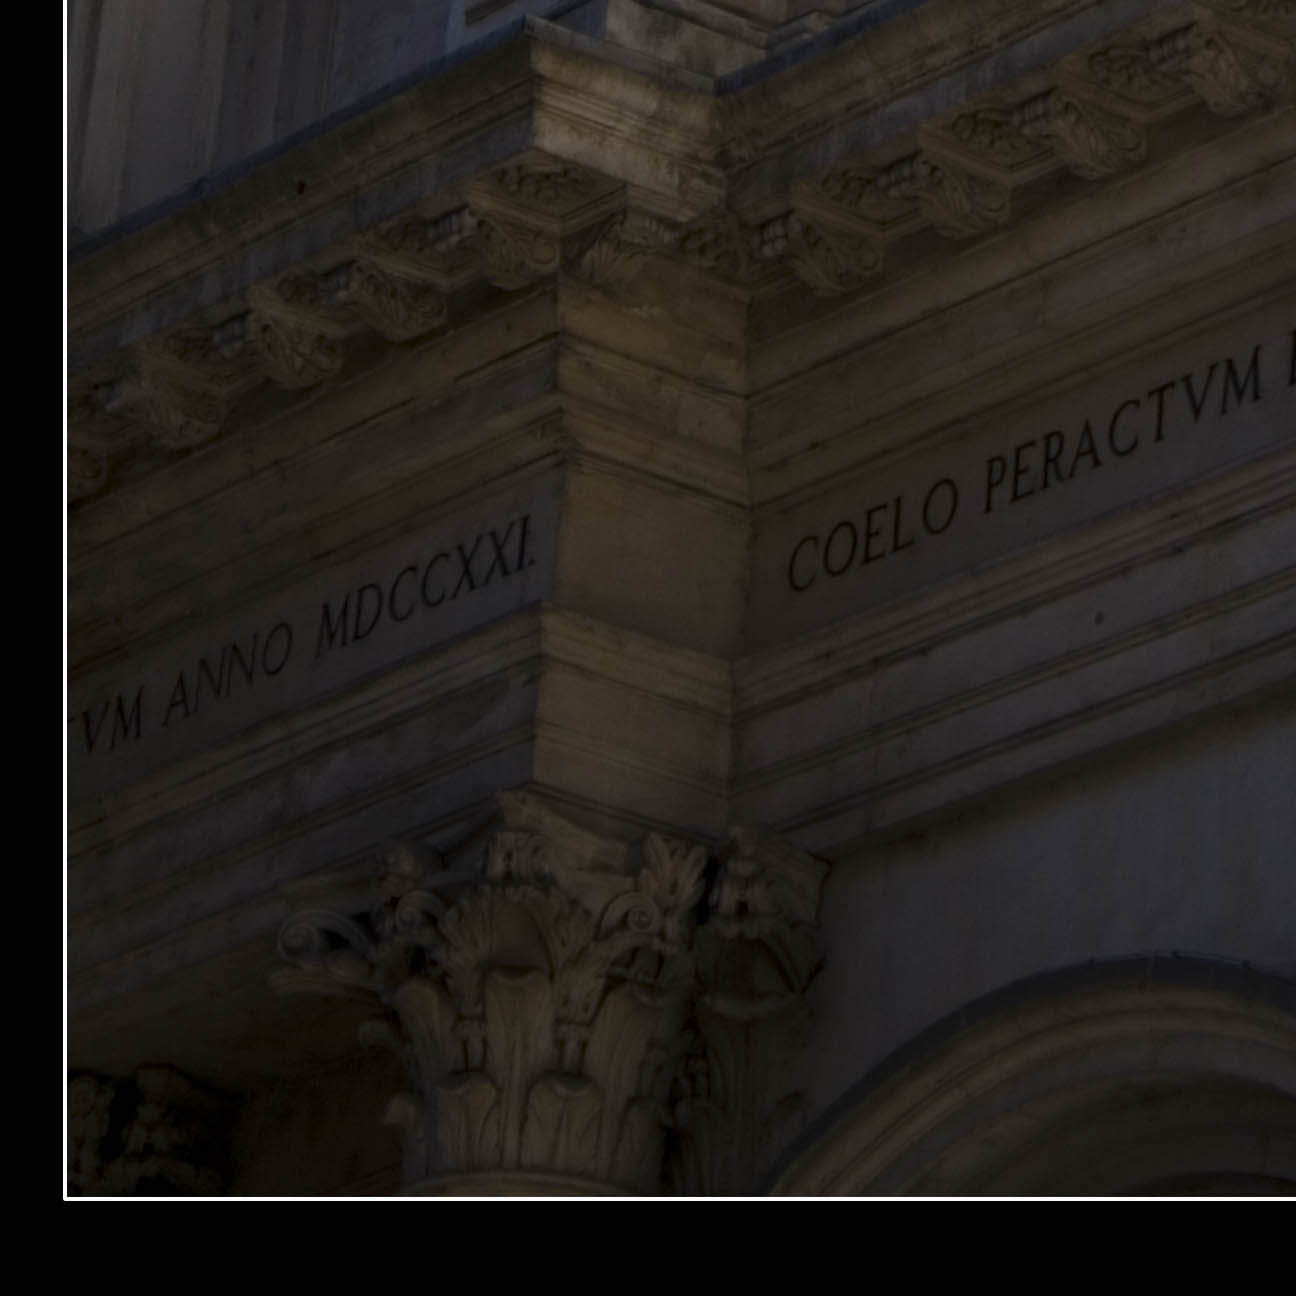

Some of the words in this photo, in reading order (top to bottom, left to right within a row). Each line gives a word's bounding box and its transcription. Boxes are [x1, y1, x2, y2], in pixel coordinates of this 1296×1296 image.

[788, 478, 959, 593] COELO
[983, 344, 1263, 513] PERACTVM
[67, 685, 145, 753] VM
[161, 623, 293, 728] ANNO
